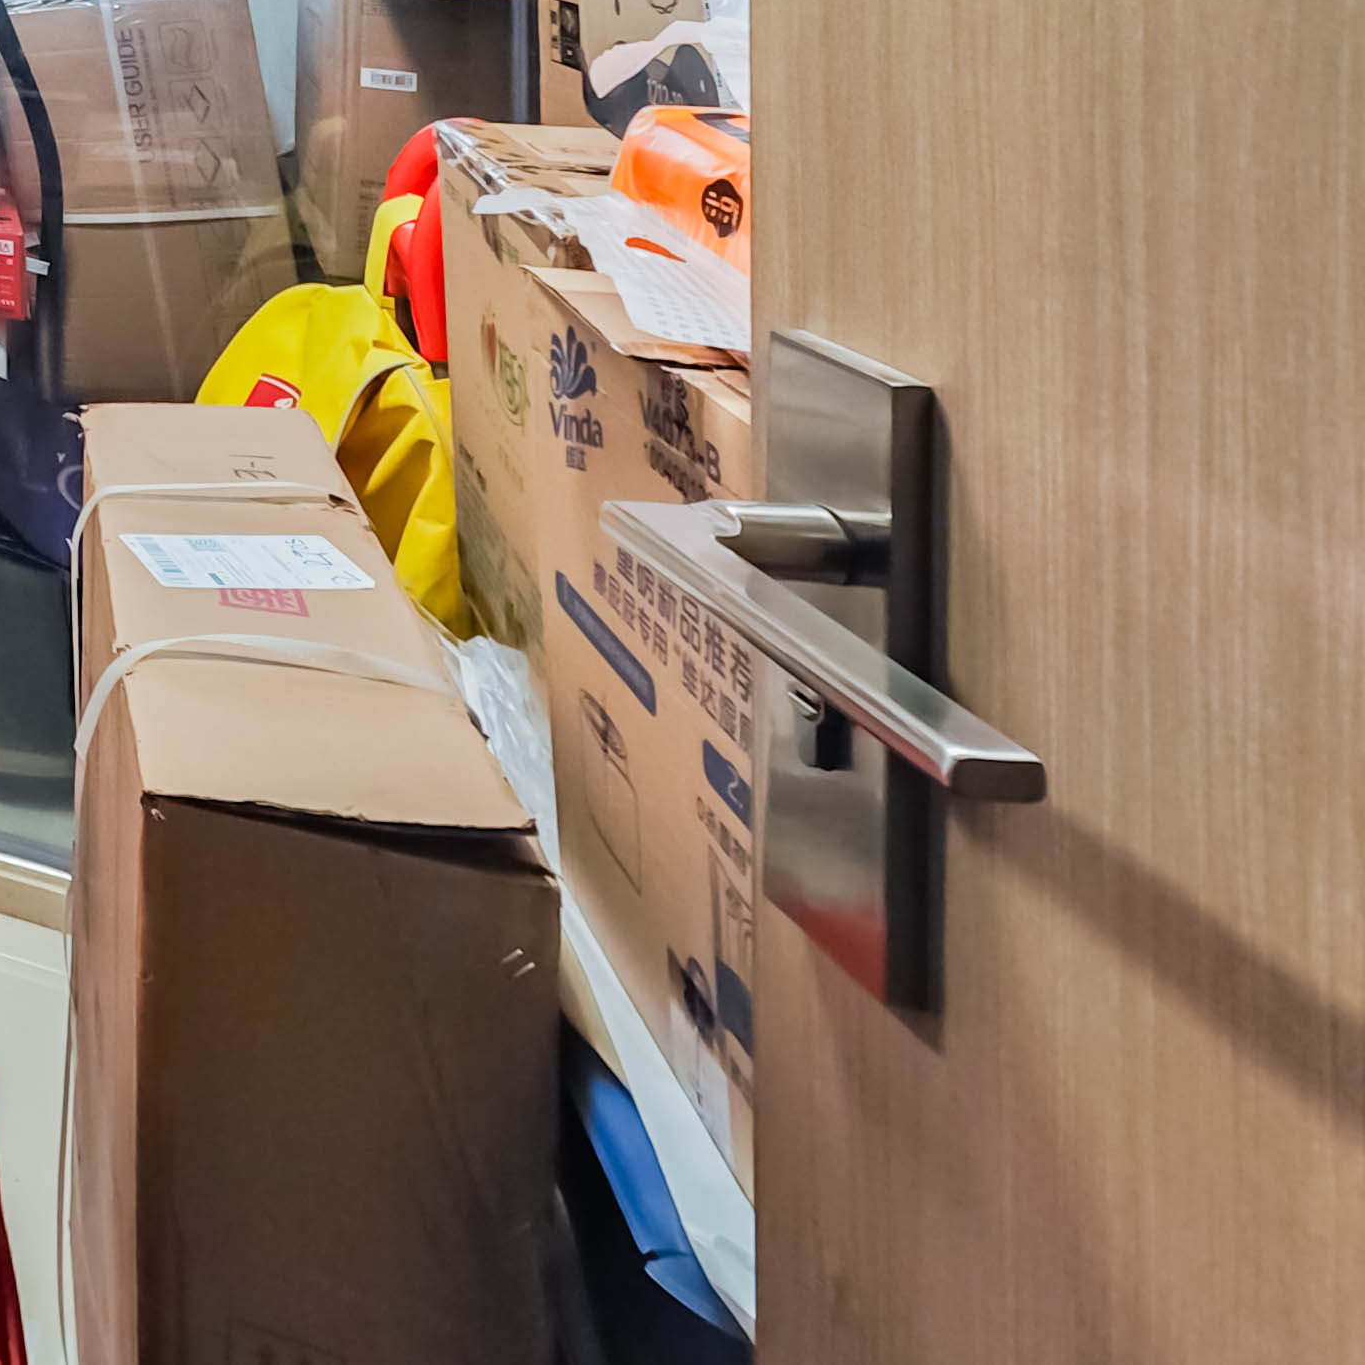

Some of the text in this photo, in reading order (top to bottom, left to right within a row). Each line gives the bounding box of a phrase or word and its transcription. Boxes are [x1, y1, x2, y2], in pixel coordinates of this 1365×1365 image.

[119, 27, 144, 98] GUIDE
[128, 101, 156, 164] USER
[549, 401, 604, 449] Vinda
